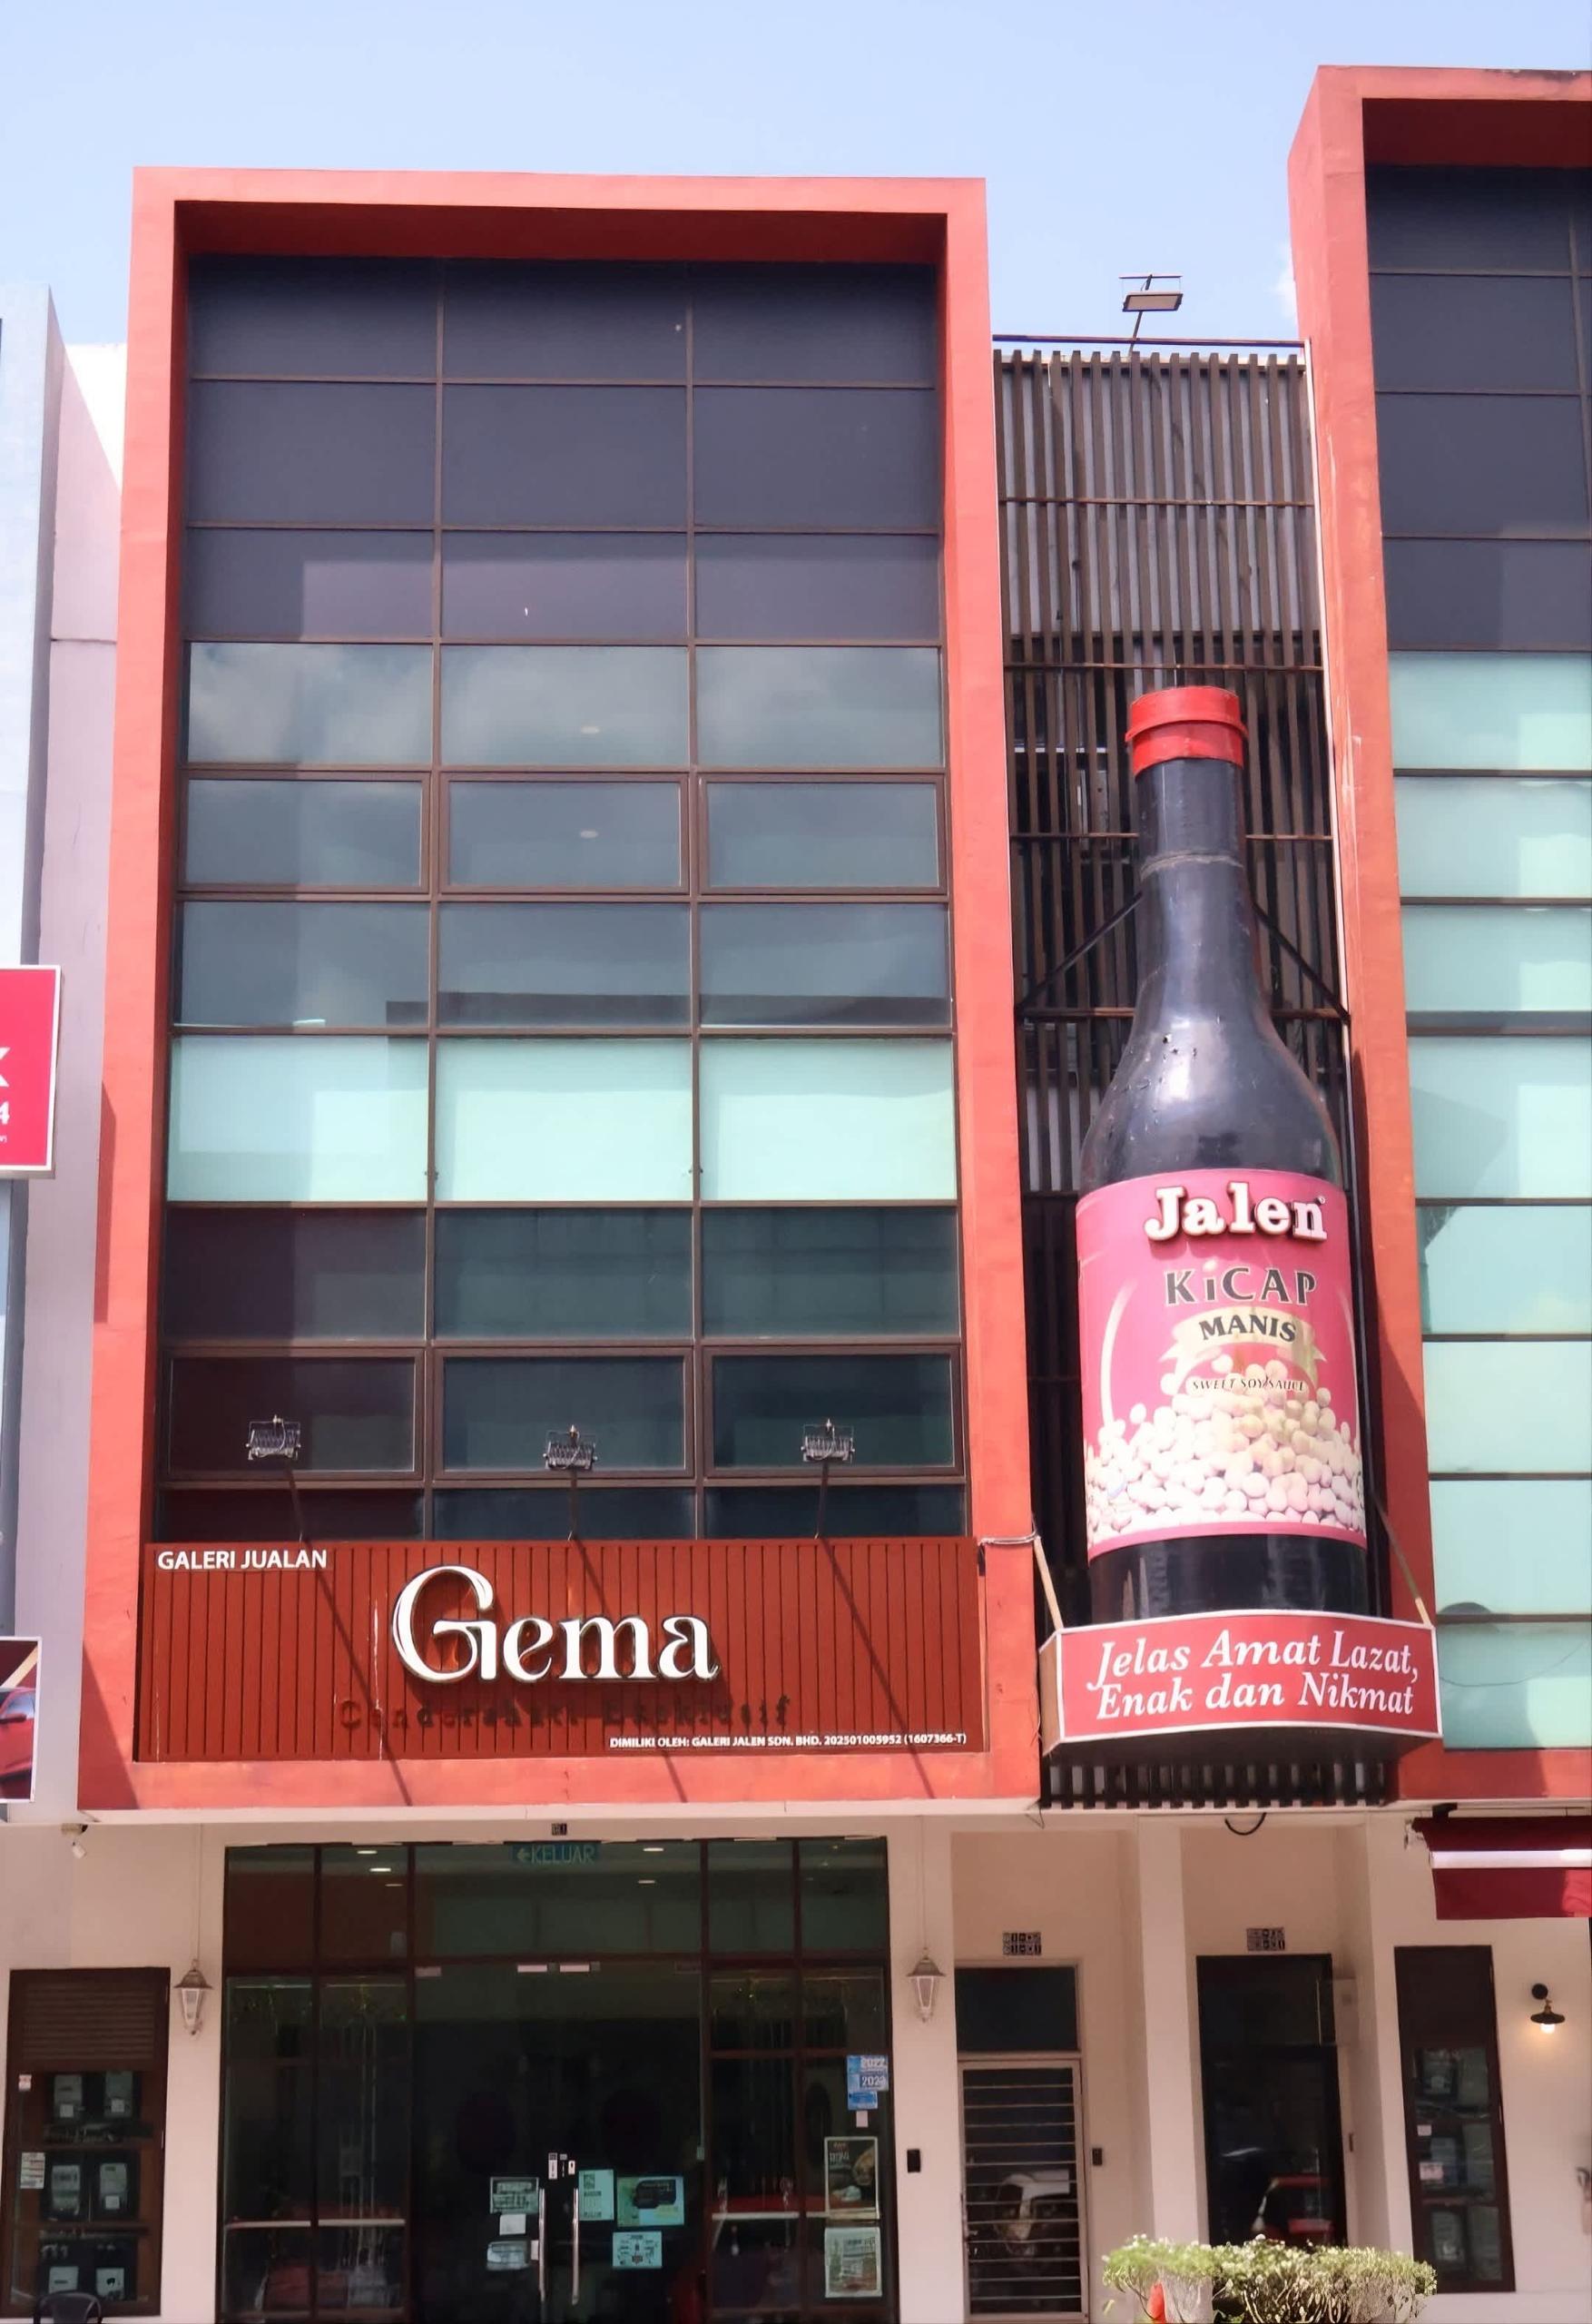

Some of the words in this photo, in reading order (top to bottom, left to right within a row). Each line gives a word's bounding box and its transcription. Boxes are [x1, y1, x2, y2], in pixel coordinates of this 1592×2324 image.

[1144, 1182, 1328, 1242] Jalen
[1198, 1315, 1298, 1343] MANIS
[1193, 1380, 1235, 1391] SWEET
[158, 1551, 235, 1570] GALERI
[241, 1549, 328, 1570] JUALAN
[392, 1565, 721, 1683] Gema
[1086, 1638, 1191, 1690] Jelas
[1201, 1630, 1321, 1668] Amat
[1330, 1631, 1419, 1682] Lazat,
[1096, 1678, 1194, 1719] Enak
[1205, 1673, 1284, 1709] dan
[1298, 1671, 1413, 1714] Nikmat
[609, 1738, 655, 1748] DIMILIKI
[657, 1738, 690, 1748] OLEH:
[692, 1736, 731, 1747] GALERI
[732, 1736, 765, 1747] JALEN
[768, 1736, 794, 1747] SDN.
[796, 1736, 821, 1746] BHD.
[531, 1844, 595, 1864] KELUAR
